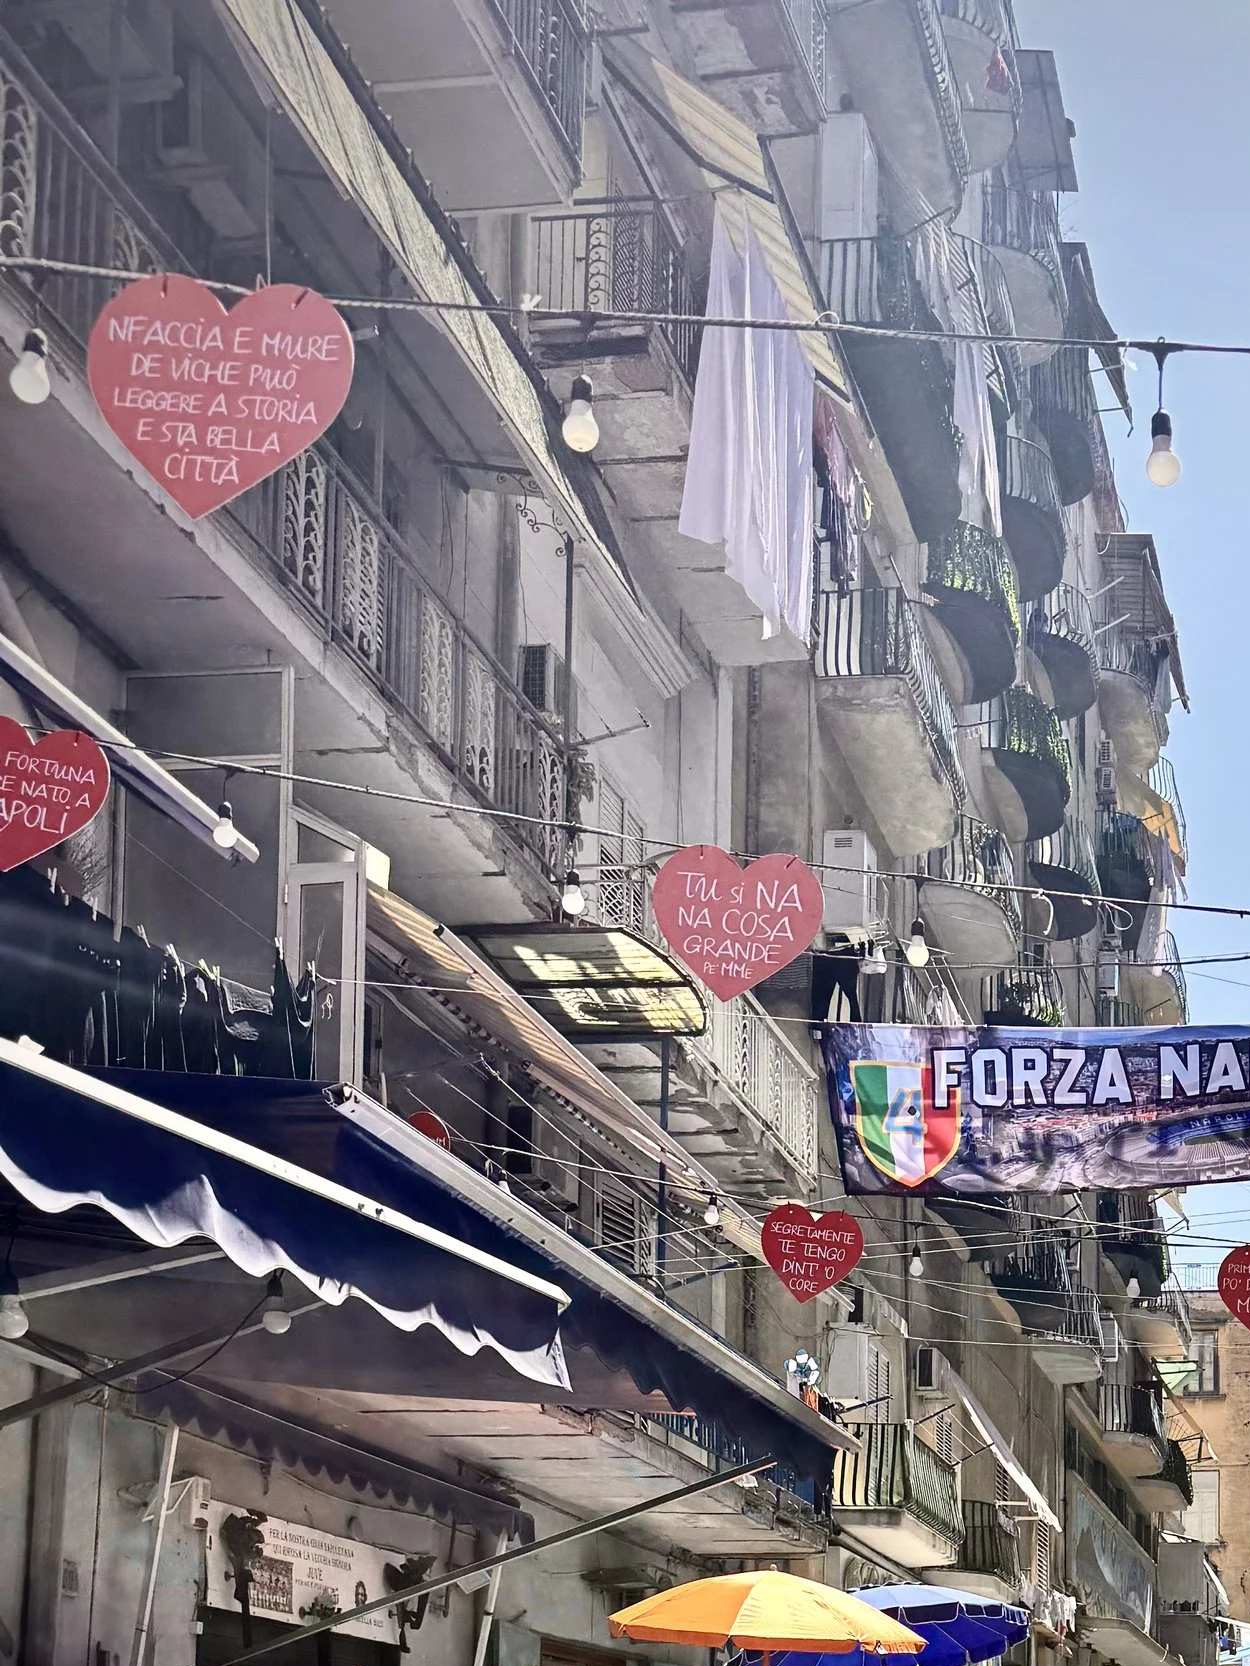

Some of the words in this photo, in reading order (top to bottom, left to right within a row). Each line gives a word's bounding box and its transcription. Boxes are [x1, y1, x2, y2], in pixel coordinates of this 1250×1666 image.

[109, 315, 224, 352] NFACCIA
[234, 326, 253, 354] E
[262, 331, 342, 362] MURE
[130, 352, 163, 378] DE
[114, 387, 204, 414] LEGGERE
[208, 392, 228, 417] A
[234, 394, 318, 425] STORIA
[136, 418, 155, 442] E
[160, 421, 198, 447] STA
[206, 425, 281, 454] BELLA
[164, 448, 240, 486] CITTÀ
[5, 750, 96, 786] FORTUNA
[21, 780, 71, 804] NATO
[75, 792, 91, 809] A
[677, 870, 723, 903] TU
[756, 880, 803, 913] NA
[678, 904, 712, 929] NA
[721, 908, 794, 943] COSA
[683, 934, 783, 965] GRANDE
[931, 1046, 1133, 1108] FORZA
[881, 1087, 929, 1144] 4
[770, 1221, 856, 1245] SEGRETAMENTE
[778, 1238, 797, 1254] TE
[800, 1242, 846, 1262] TENGO
[789, 1277, 819, 1293] CORE
